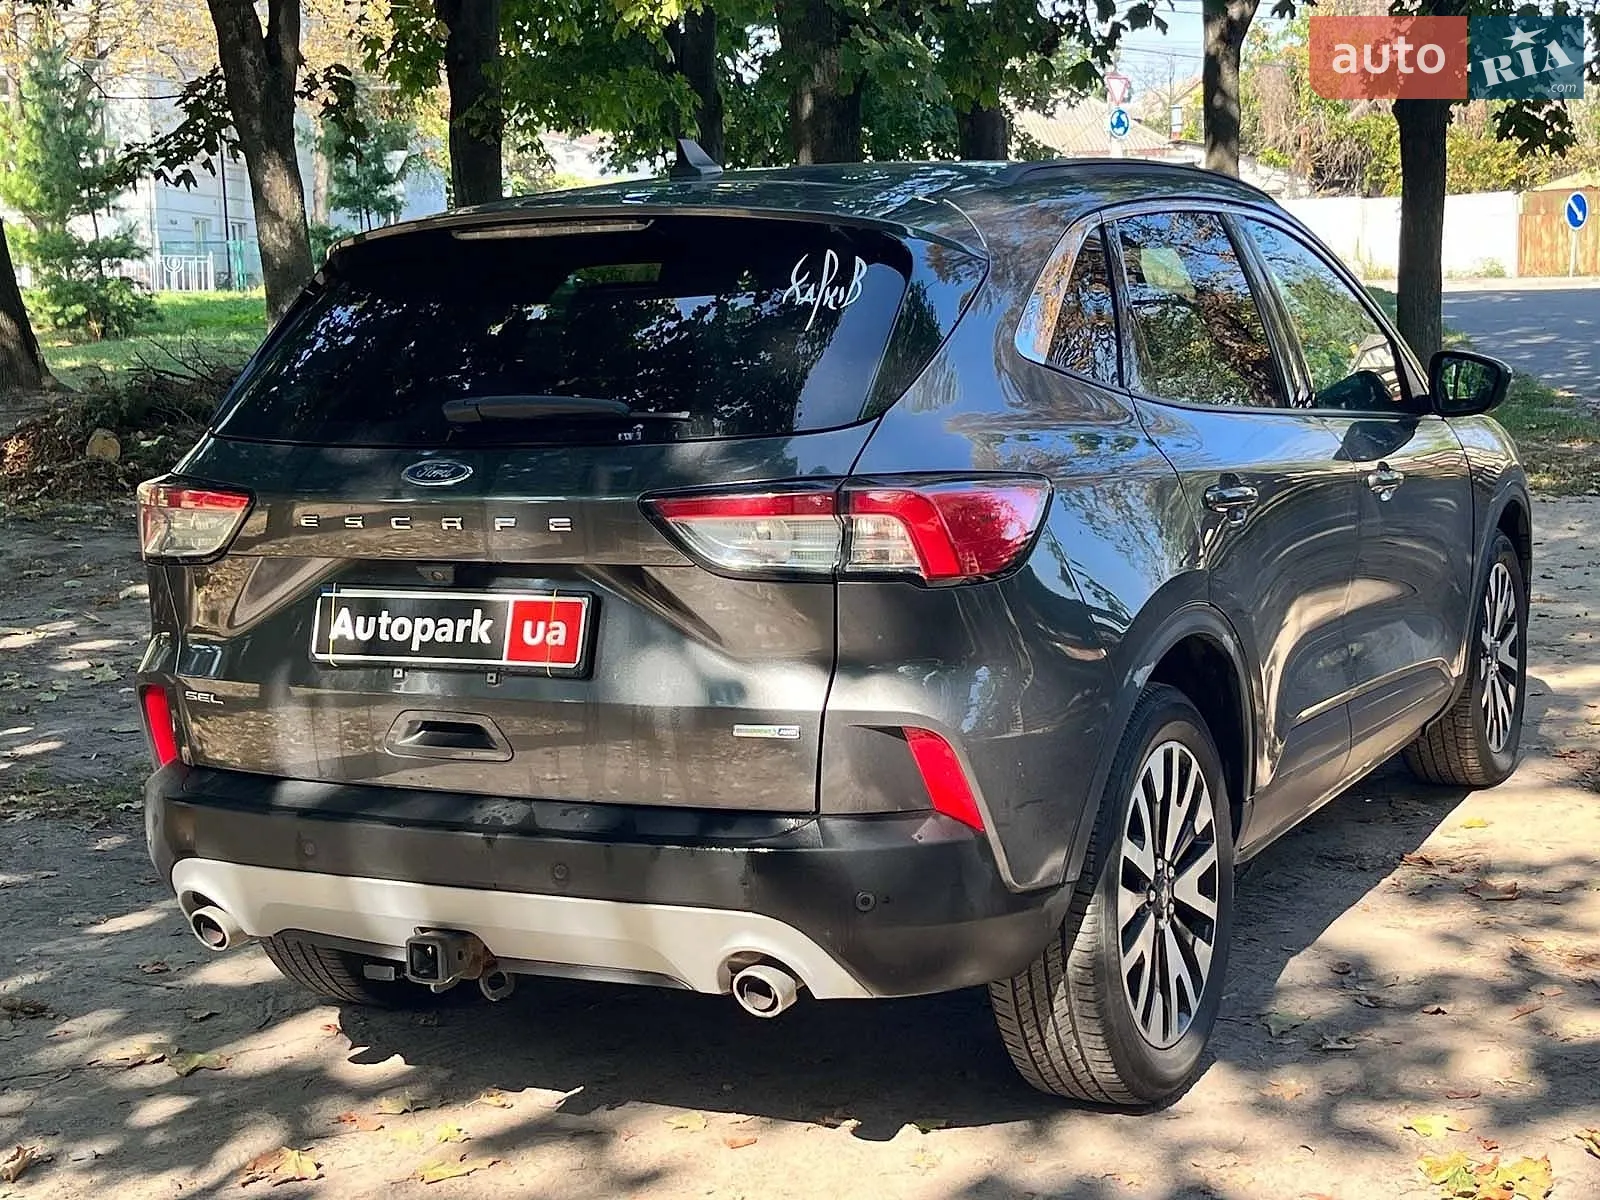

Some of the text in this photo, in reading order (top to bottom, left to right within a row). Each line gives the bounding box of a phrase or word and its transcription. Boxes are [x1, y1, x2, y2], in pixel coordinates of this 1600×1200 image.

[415, 463, 457, 478] Ford
[299, 514, 573, 532] ESCAPE
[330, 607, 567, 652] Autopark ua
[185, 690, 225, 705] SEL
